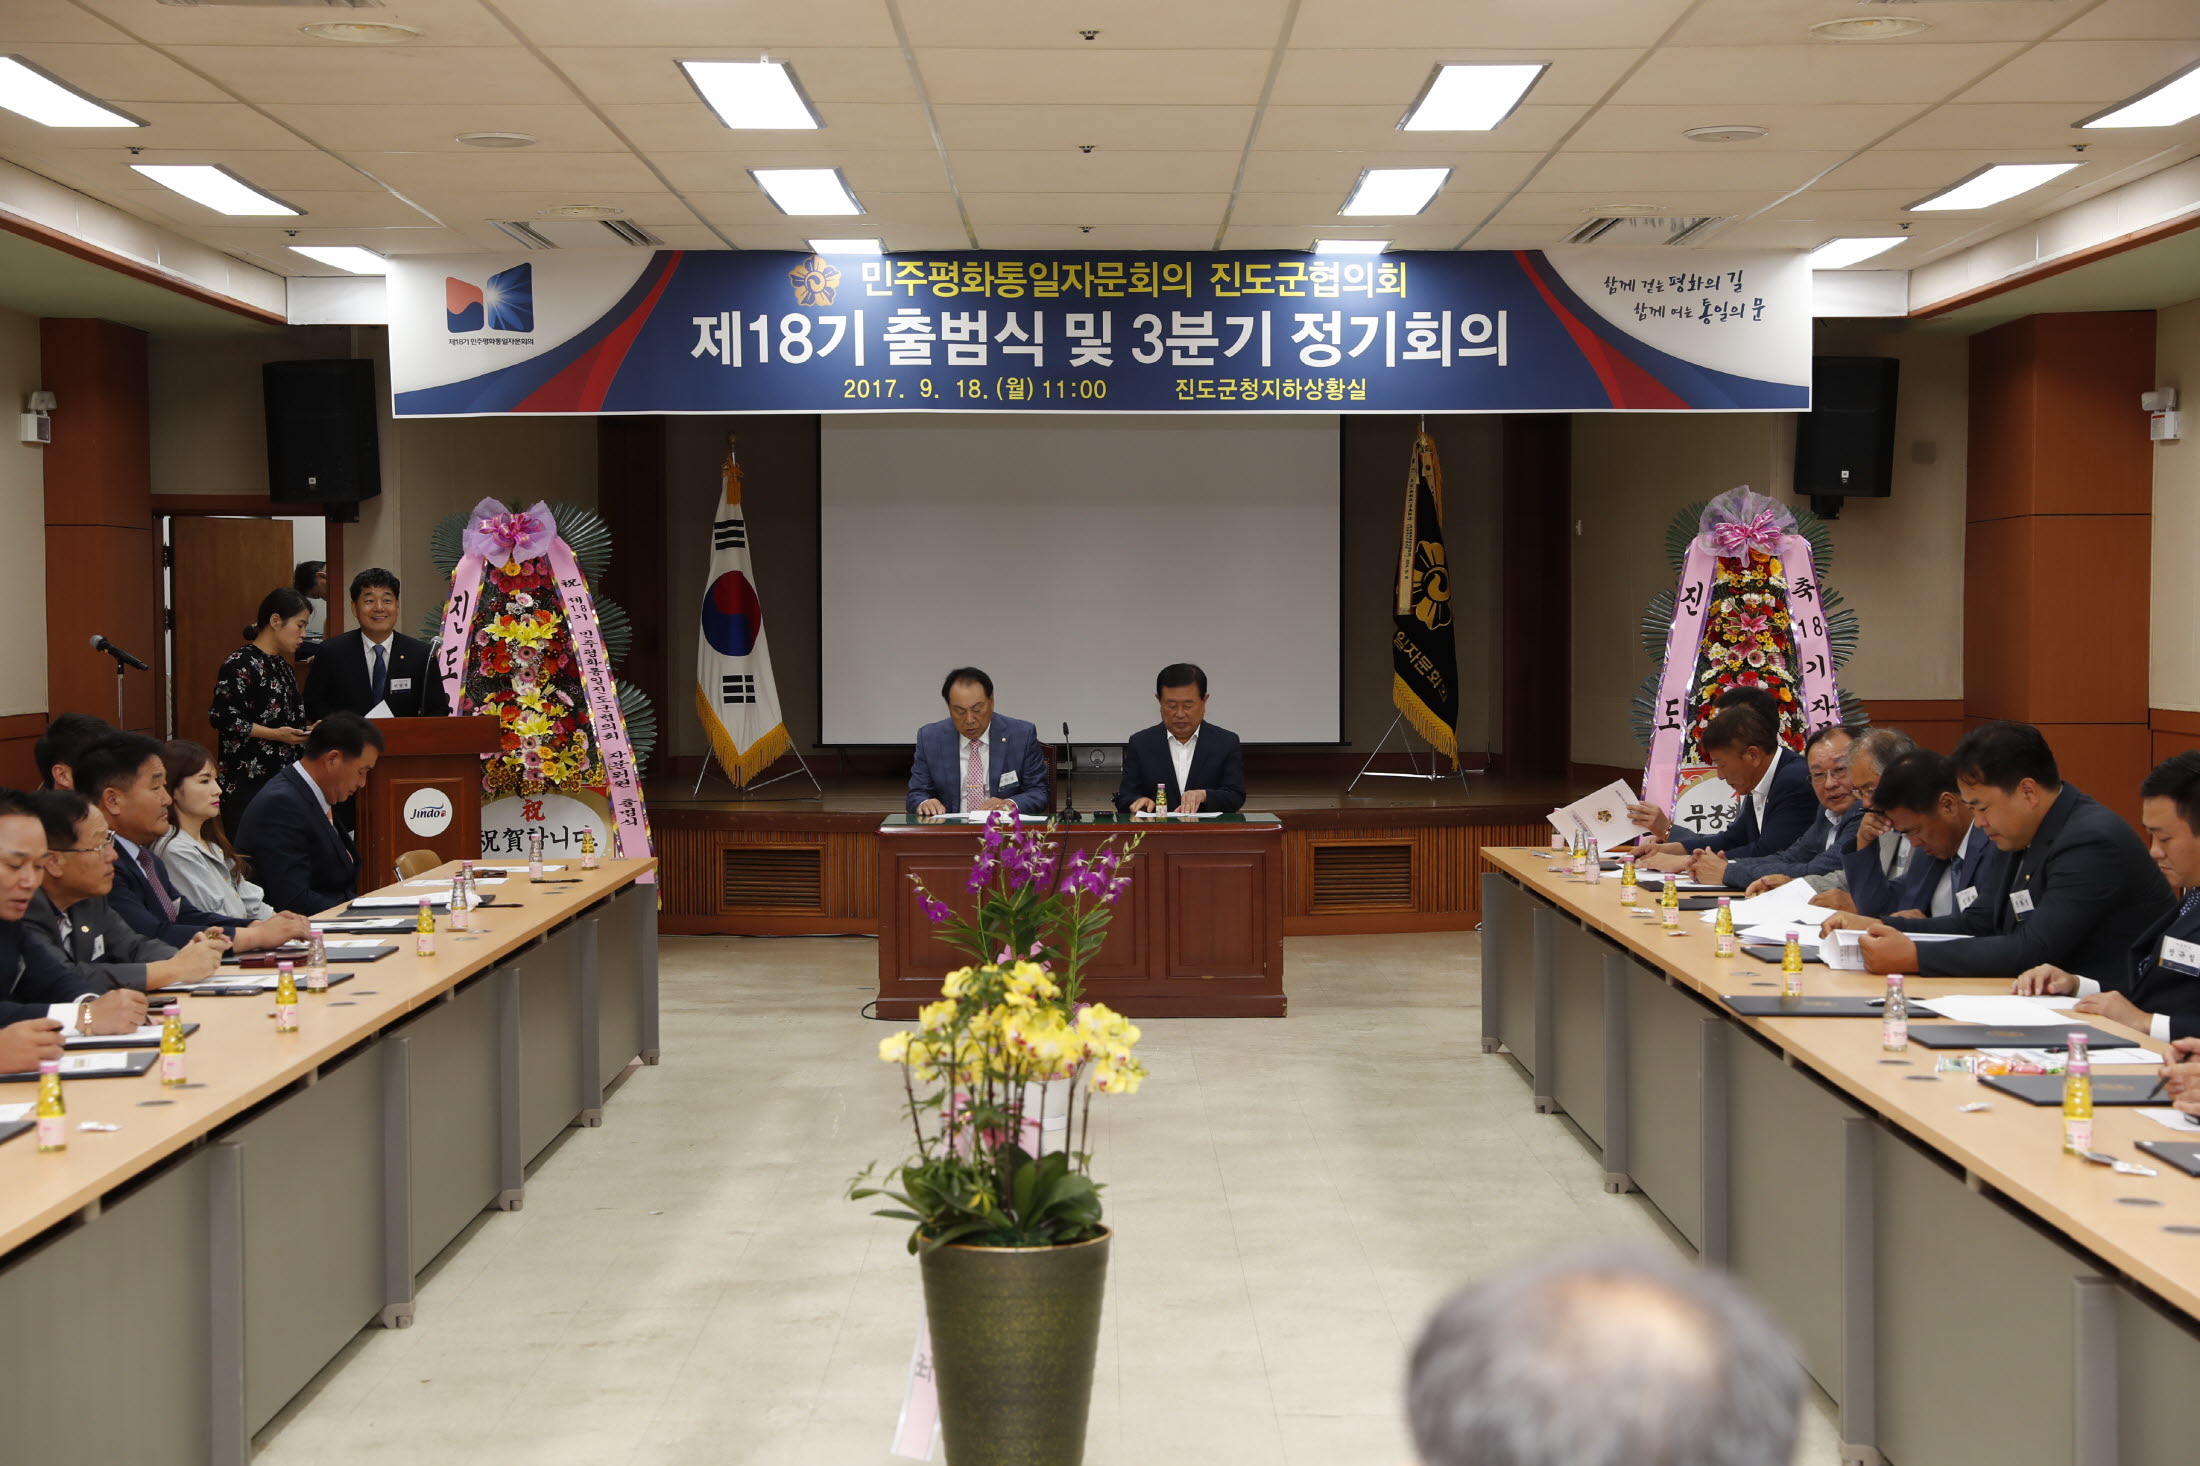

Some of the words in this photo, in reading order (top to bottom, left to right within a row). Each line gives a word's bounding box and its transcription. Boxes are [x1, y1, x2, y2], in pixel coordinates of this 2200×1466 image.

[861, 261, 1192, 299] 민주평화통일자문회의
[1210, 262, 1408, 299] 진도군협의회
[1603, 275, 1636, 295] 함께
[1641, 278, 1665, 294] 걷는
[1668, 273, 1721, 293] 평화의
[1726, 270, 1744, 294] 길
[1633, 302, 1666, 322] 함께
[1671, 305, 1694, 319] 여는
[1698, 298, 1746, 325] 통일의
[1751, 297, 1767, 322] 문
[448, 338, 470, 346] 제18기
[691, 309, 865, 368] 제18기
[881, 309, 1044, 368] 출범식
[1064, 311, 1115, 368] 및
[1131, 310, 1272, 368] 3분기
[1290, 310, 1509, 368] 정기회의
[844, 379, 905, 399] 2017.
[919, 378, 940, 399] 9.
[1043, 379, 1107, 399] 11:00
[1177, 379, 1367, 401] 진도군청지하상황실
[1792, 577, 1816, 603] 축
[410, 808, 441, 820] Jindo
[520, 798, 547, 823] 祝
